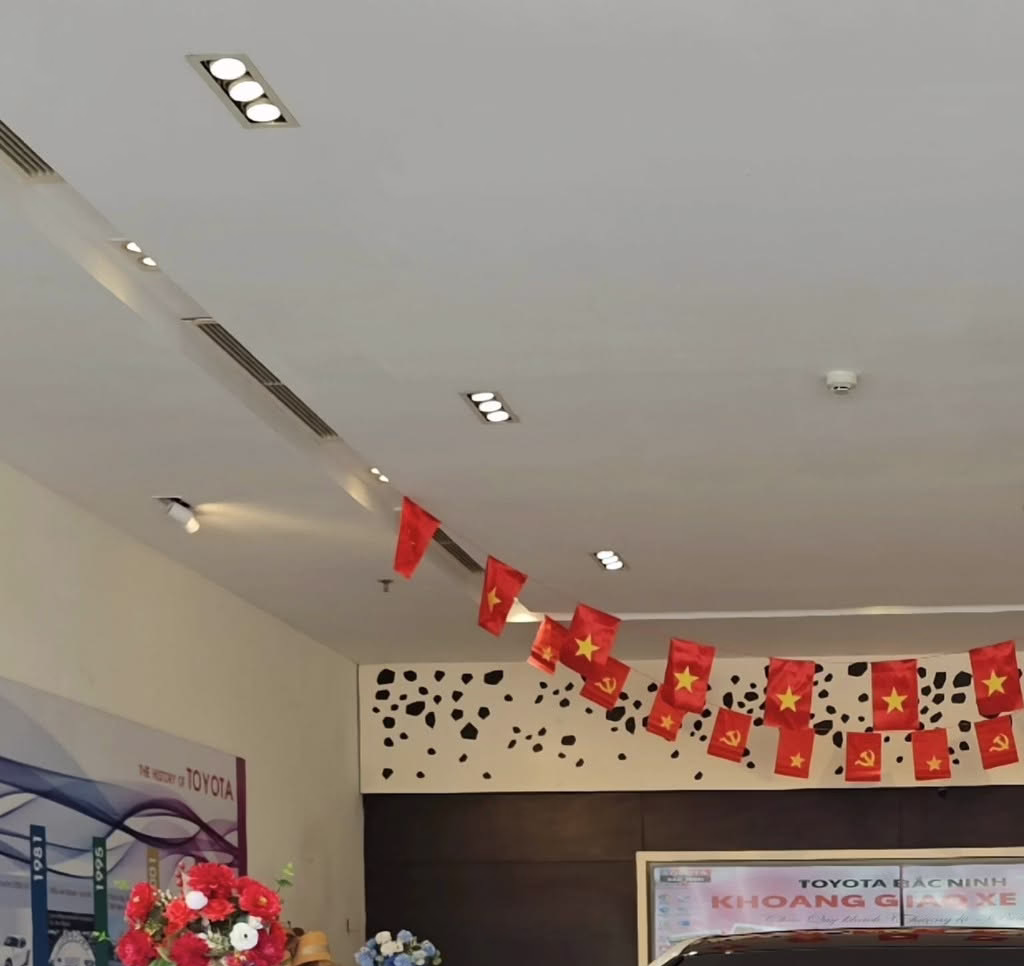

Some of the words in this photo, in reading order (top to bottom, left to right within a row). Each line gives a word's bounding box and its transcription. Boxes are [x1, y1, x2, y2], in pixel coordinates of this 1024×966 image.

[186, 767, 234, 801] TOYOTA
[32, 836, 44, 881] 1981
[798, 878, 886, 889] TOYOTA
[946, 877, 1008, 888] NINH
[711, 894, 866, 909] KHOANG
[874, 893, 969, 909] GIAO
[974, 891, 1018, 907] XE
